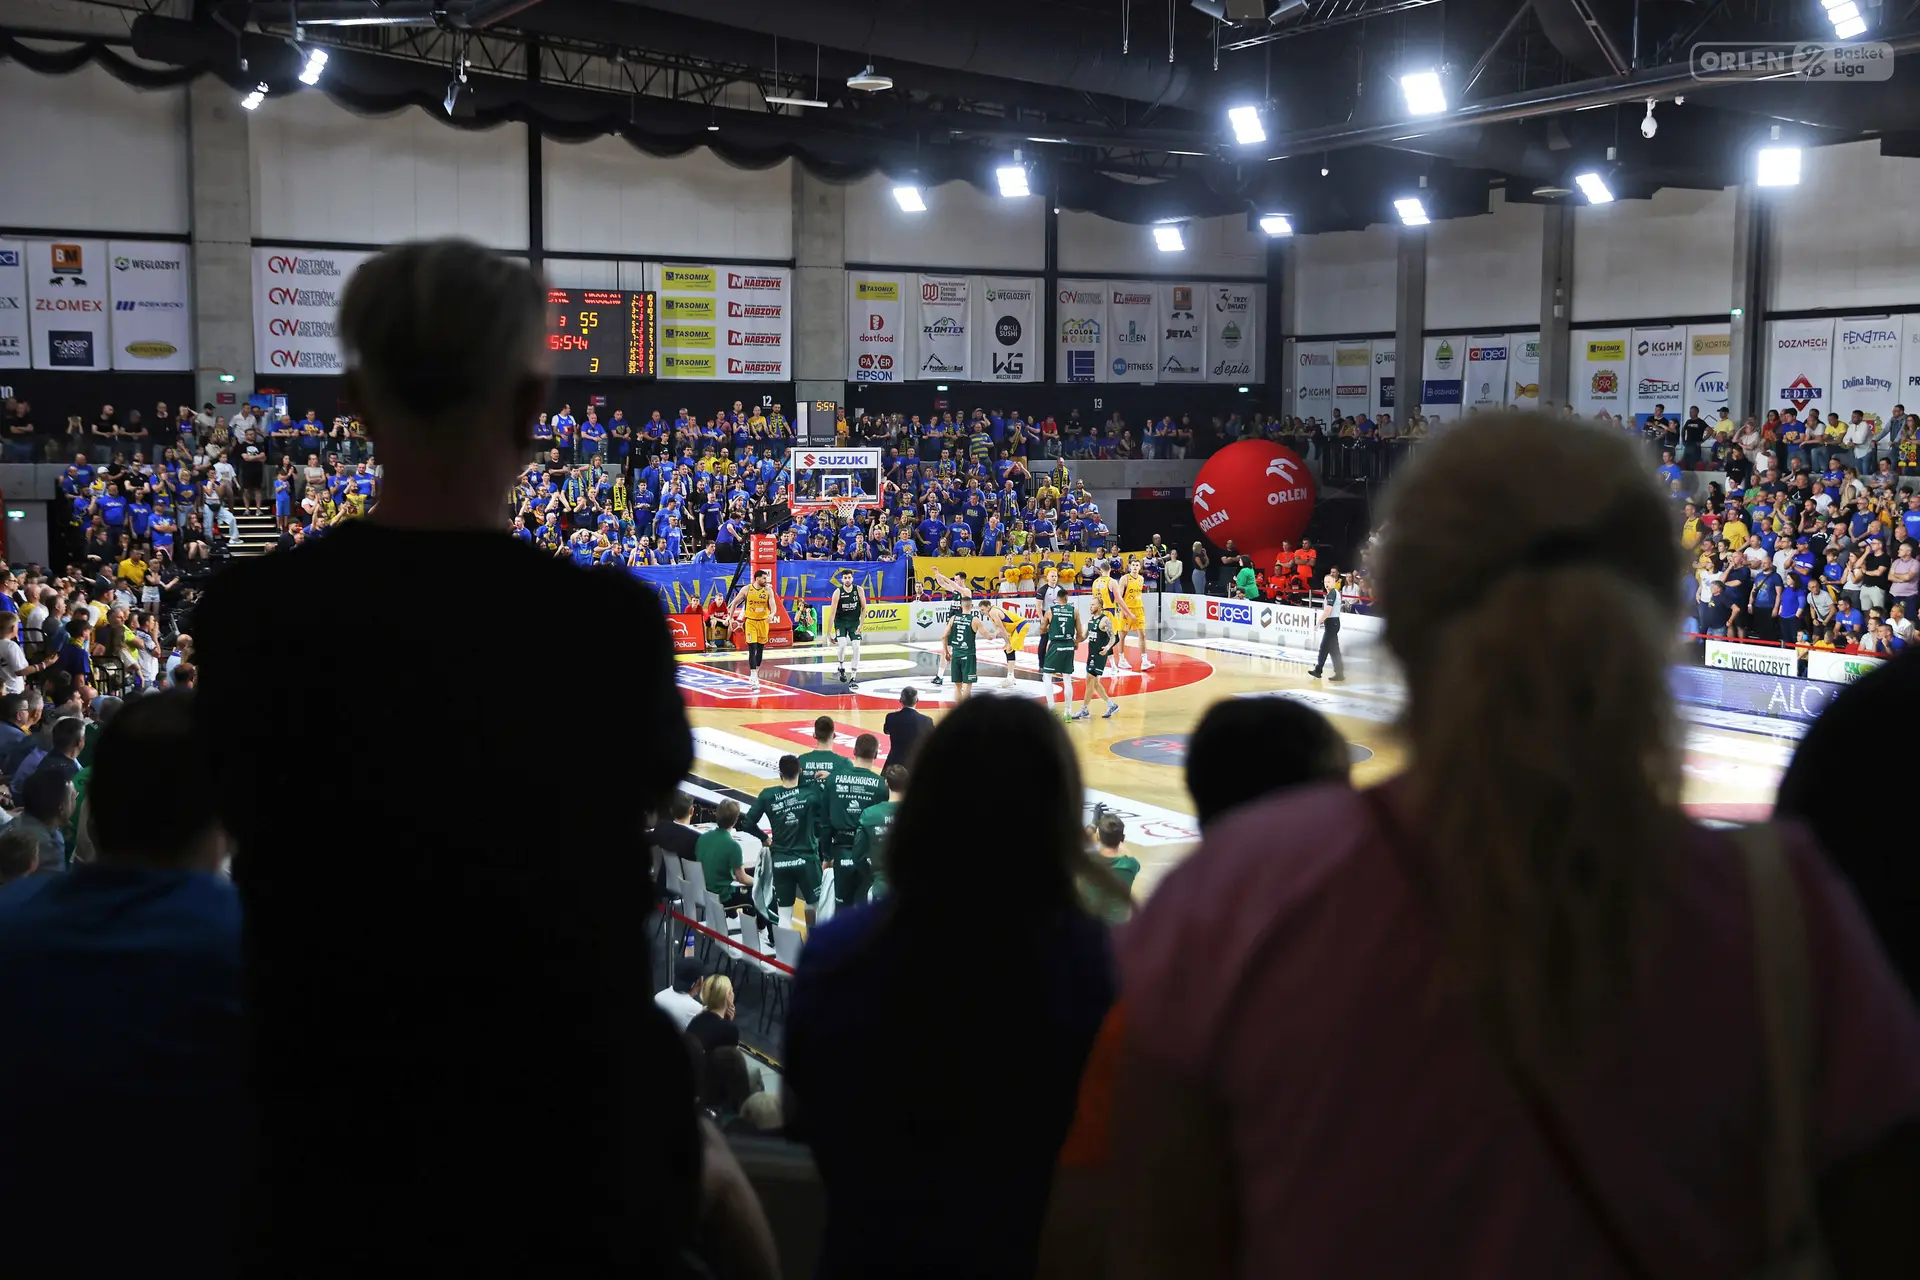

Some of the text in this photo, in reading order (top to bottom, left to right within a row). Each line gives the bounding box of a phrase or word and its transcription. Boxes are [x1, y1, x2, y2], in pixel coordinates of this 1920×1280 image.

[55, 249, 78, 263] BM
[298, 258, 334, 269] OSTRÓW
[744, 280, 781, 288] NABZDYK
[298, 289, 335, 300] OSTRÓW
[997, 292, 1031, 301] WĘGLOZBYT
[35, 299, 103, 312] ZŁOMEX
[675, 301, 709, 310] TASOMIX
[744, 308, 781, 316] NABZDYK
[559, 315, 567, 327] 3
[580, 311, 598, 327] 55
[299, 321, 336, 331] OSTRÓW
[675, 330, 709, 338] TASOMIX
[859, 333, 894, 342] dostfood
[1166, 329, 1193, 340] JETA
[550, 335, 582, 350] 5:54
[744, 336, 781, 344] NABZDYK
[1778, 338, 1828, 349] DOZAMECH
[1651, 341, 1682, 352] KGHM
[300, 352, 337, 361] OSTRÓW
[1471, 347, 1506, 360] arged
[590, 357, 599, 373] 3
[744, 364, 781, 372] NABZDYK
[993, 352, 1023, 374] WG
[1213, 360, 1250, 376] Sepia
[856, 370, 893, 381] EPSON
[1842, 375, 1892, 392] Dolina Baryczy
[1308, 388, 1331, 396] KGHM
[1784, 389, 1818, 398] EDEX
[762, 395, 772, 407] 12
[816, 401, 835, 412] 5:54
[1094, 398, 1103, 409] 13
[818, 455, 868, 465] SUZUKI
[1267, 487, 1308, 506] ORLEN
[1199, 509, 1230, 533] ORLEN
[1208, 604, 1251, 624] arged
[1275, 611, 1310, 628] KGHM
[1060, 622, 1066, 634] 1
[956, 630, 964, 641] 5
[673, 640, 697, 648] Pekao
[835, 775, 879, 787] PARAKHOUSKI
[774, 788, 800, 801] KLASSEN
